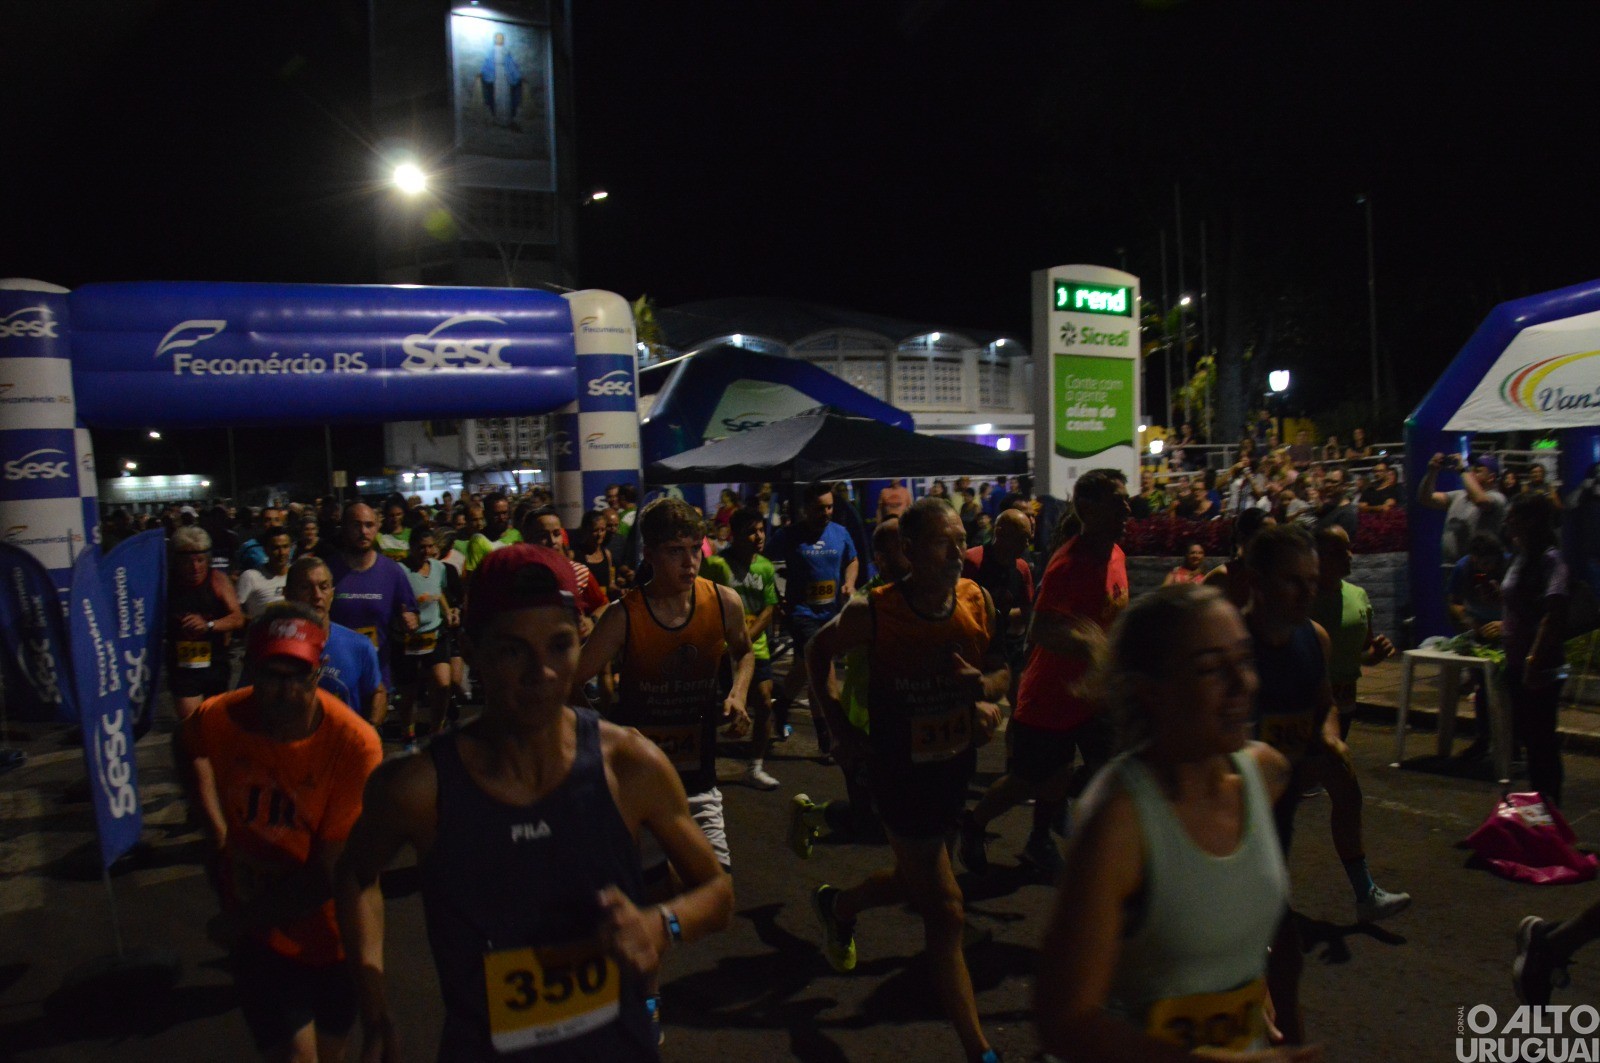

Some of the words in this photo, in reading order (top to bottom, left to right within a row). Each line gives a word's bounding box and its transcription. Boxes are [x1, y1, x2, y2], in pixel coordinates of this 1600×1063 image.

[1075, 287, 1126, 312] rend
[1080, 326, 1130, 347] Sicredi
[173, 352, 327, 376] Fecomércio
[333, 351, 369, 374] RS
[1065, 374, 1098, 390] Conte
[1099, 378, 1124, 390] com
[1065, 402, 1098, 418] além
[511, 819, 552, 844] FILA
[504, 956, 607, 1011] 350
